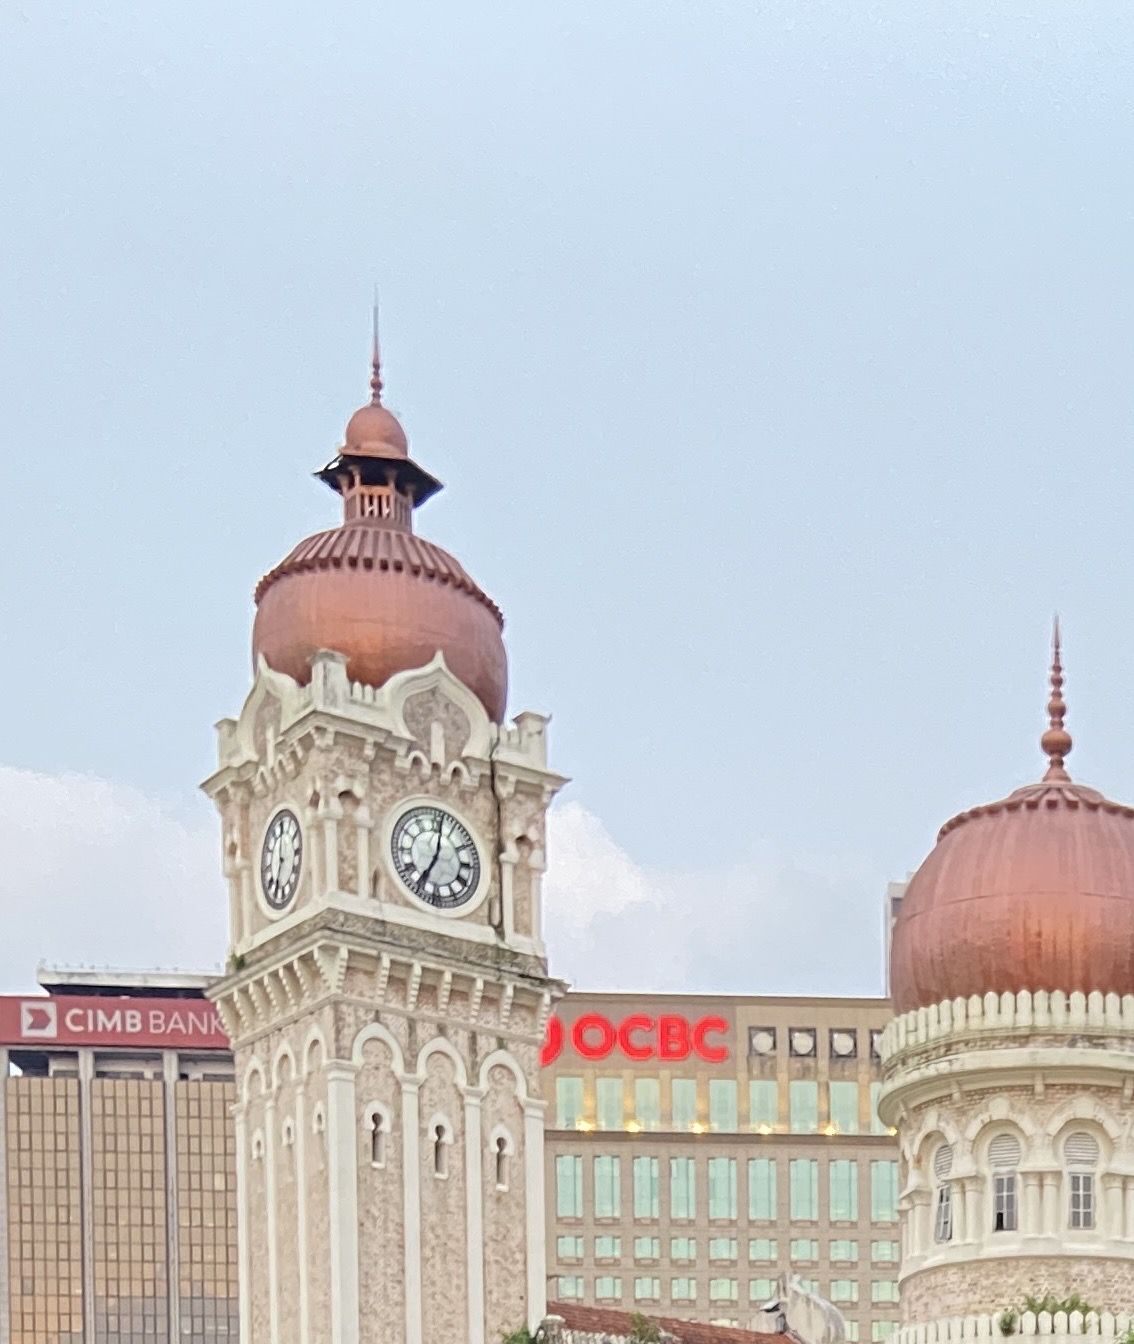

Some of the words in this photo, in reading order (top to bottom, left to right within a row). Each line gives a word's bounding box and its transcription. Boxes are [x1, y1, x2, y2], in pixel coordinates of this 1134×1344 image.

[65, 1007, 142, 1033] CIMB
[149, 1010, 226, 1035] BANK
[571, 1011, 729, 1063] OCBC
